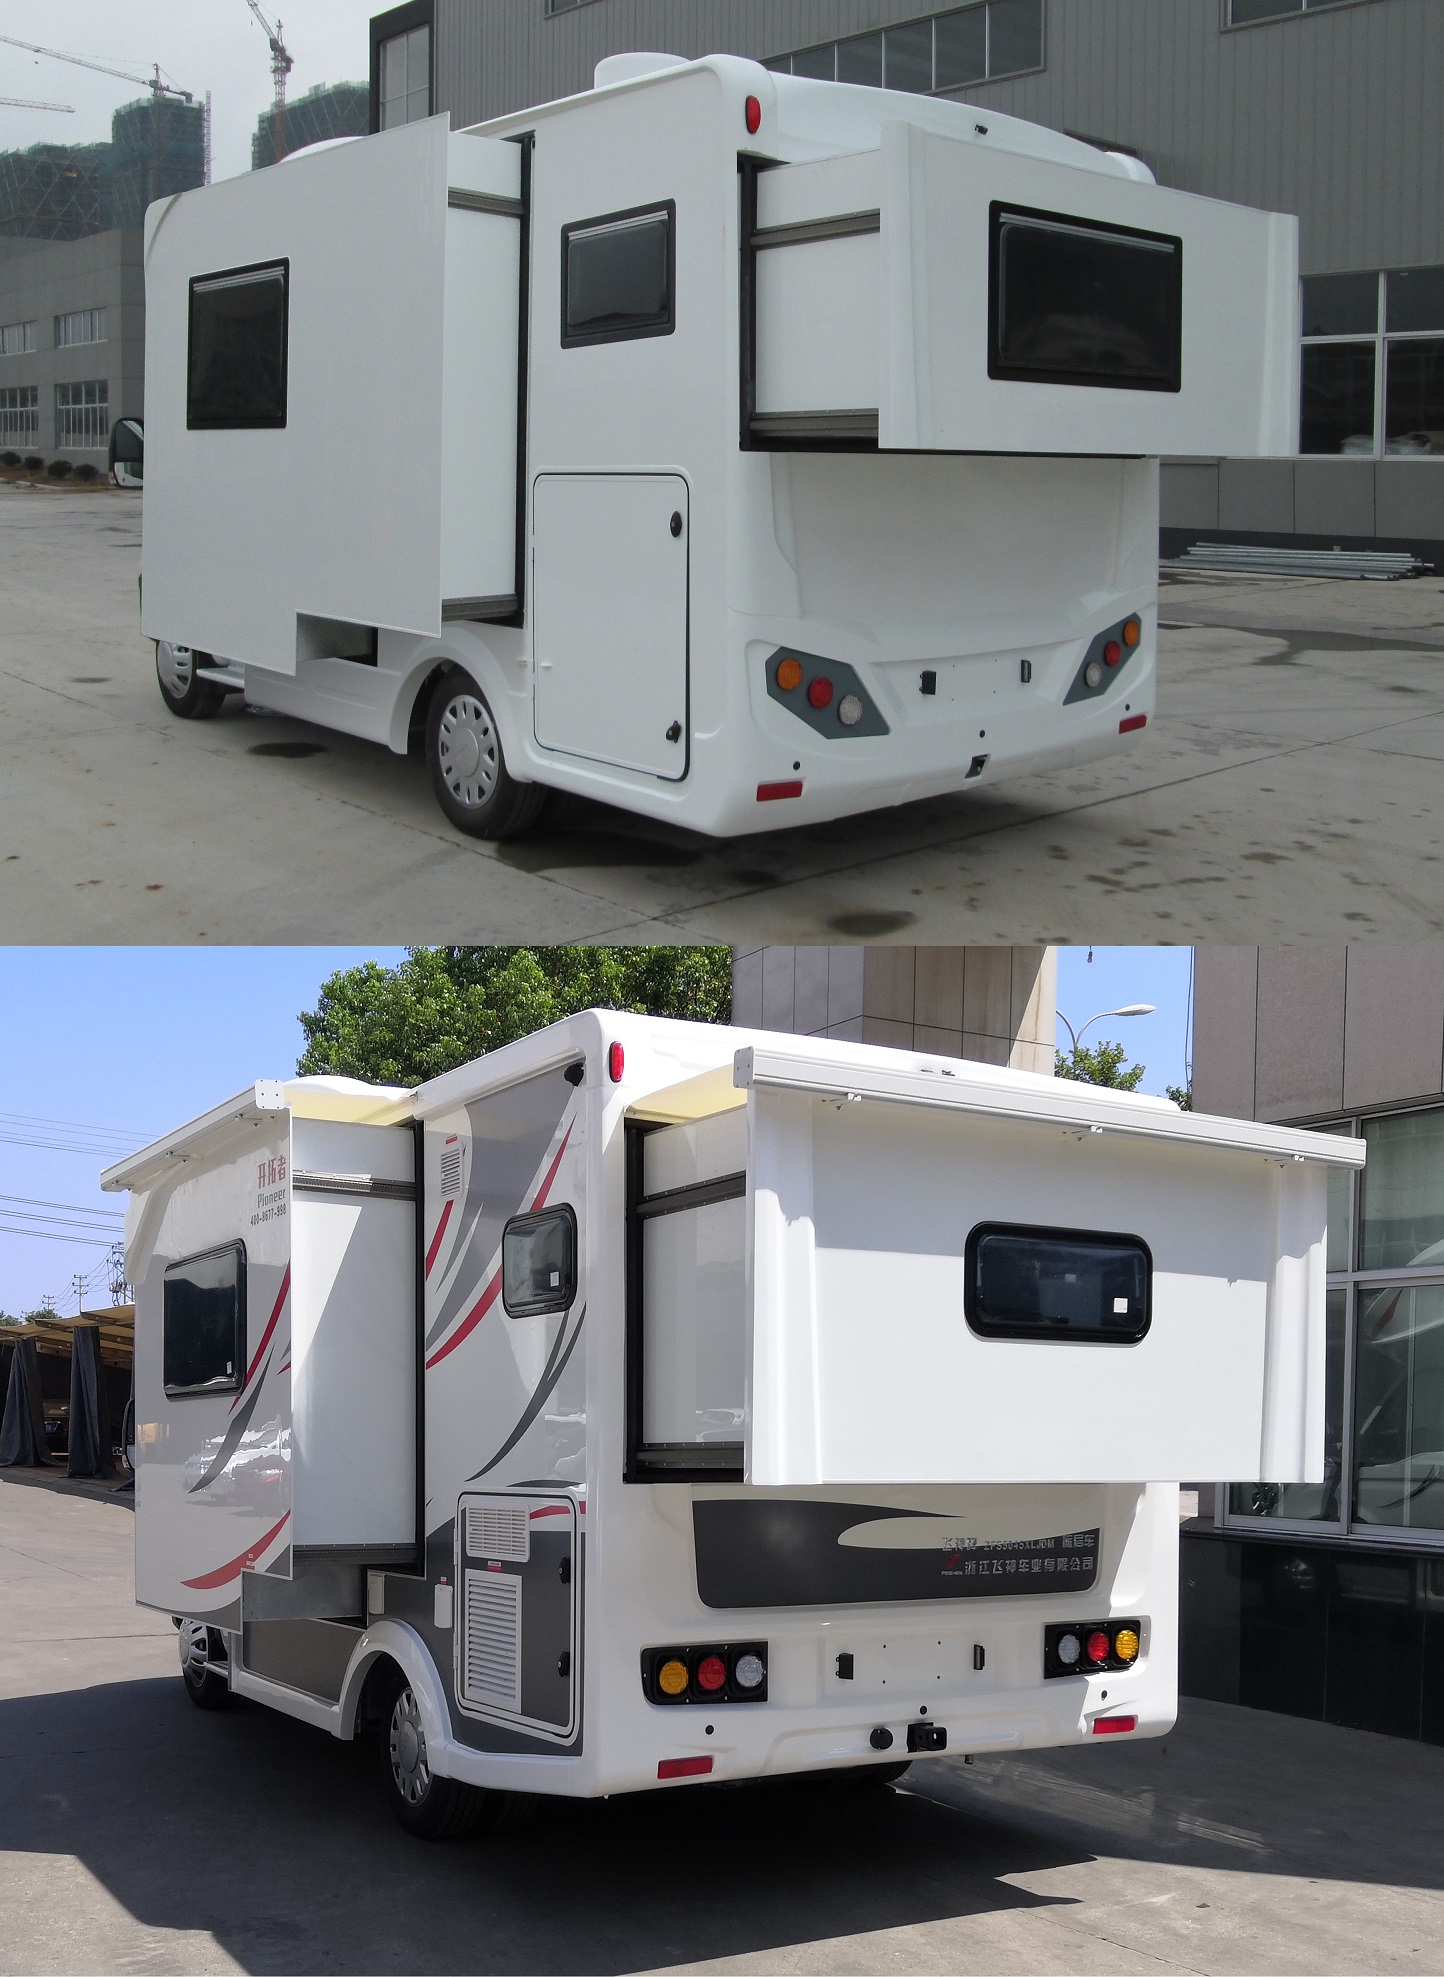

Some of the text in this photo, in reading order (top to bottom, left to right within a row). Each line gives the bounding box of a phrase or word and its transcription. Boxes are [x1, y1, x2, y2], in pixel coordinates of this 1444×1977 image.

[257, 1154, 287, 1189] 开拓者
[257, 1189, 286, 1208] Pioneer
[964, 1556, 1094, 1576] 浙江飞神车业有限公司
